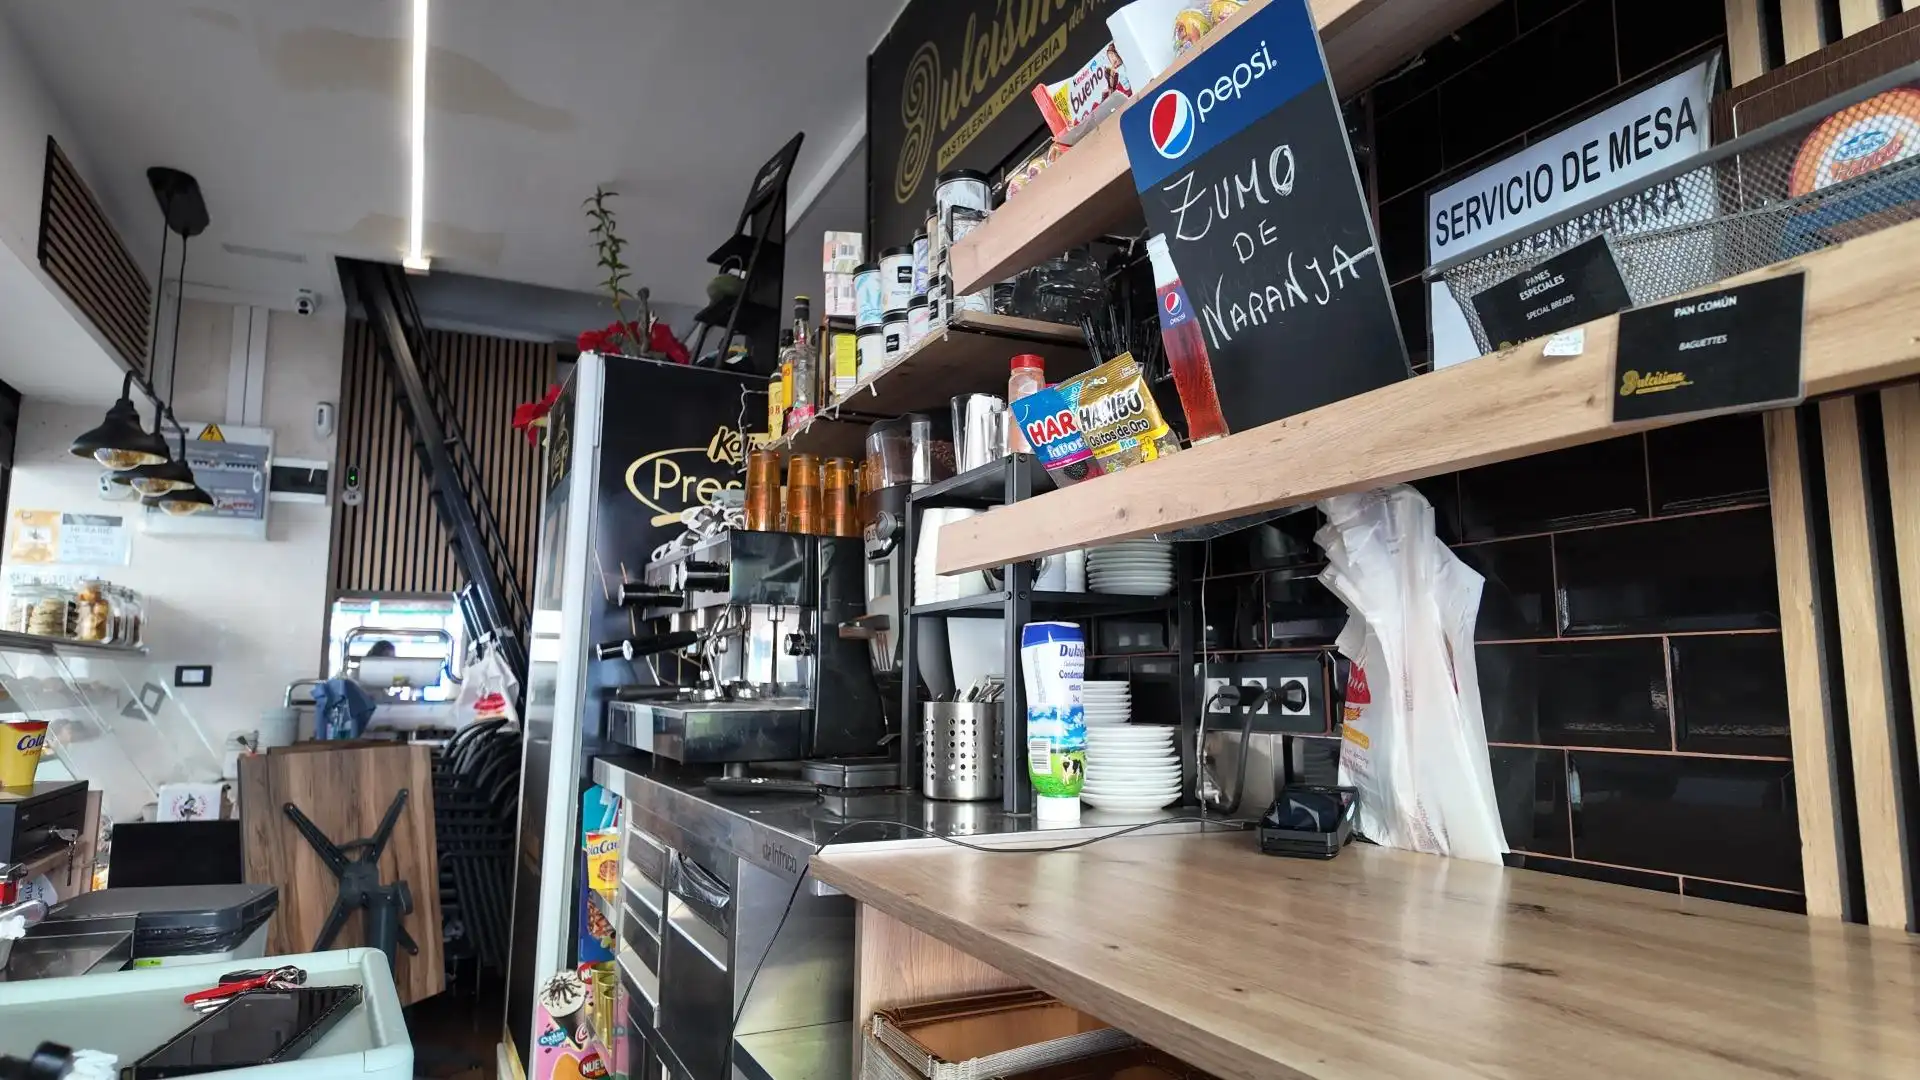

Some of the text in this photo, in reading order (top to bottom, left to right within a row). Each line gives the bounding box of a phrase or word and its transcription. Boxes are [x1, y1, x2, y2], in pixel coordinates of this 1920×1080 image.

[1070, 66, 1104, 115] bueno
[1435, 96, 1699, 248] SERVICIO DE MESA
[1163, 144, 1296, 242] ZUMO
[1232, 219, 1280, 265] DE
[1519, 274, 1567, 302] ESPECIALES
[1524, 269, 1552, 288] PANES
[1201, 244, 1376, 351] NARANJA
[1526, 293, 1576, 321] SPECIAL BREADS
[1673, 295, 1738, 318] PAN COMÚN
[1678, 334, 1728, 352] BAGUETTES
[1028, 412, 1077, 446] HAR
[1089, 418, 1150, 448] Ositos de Oro
